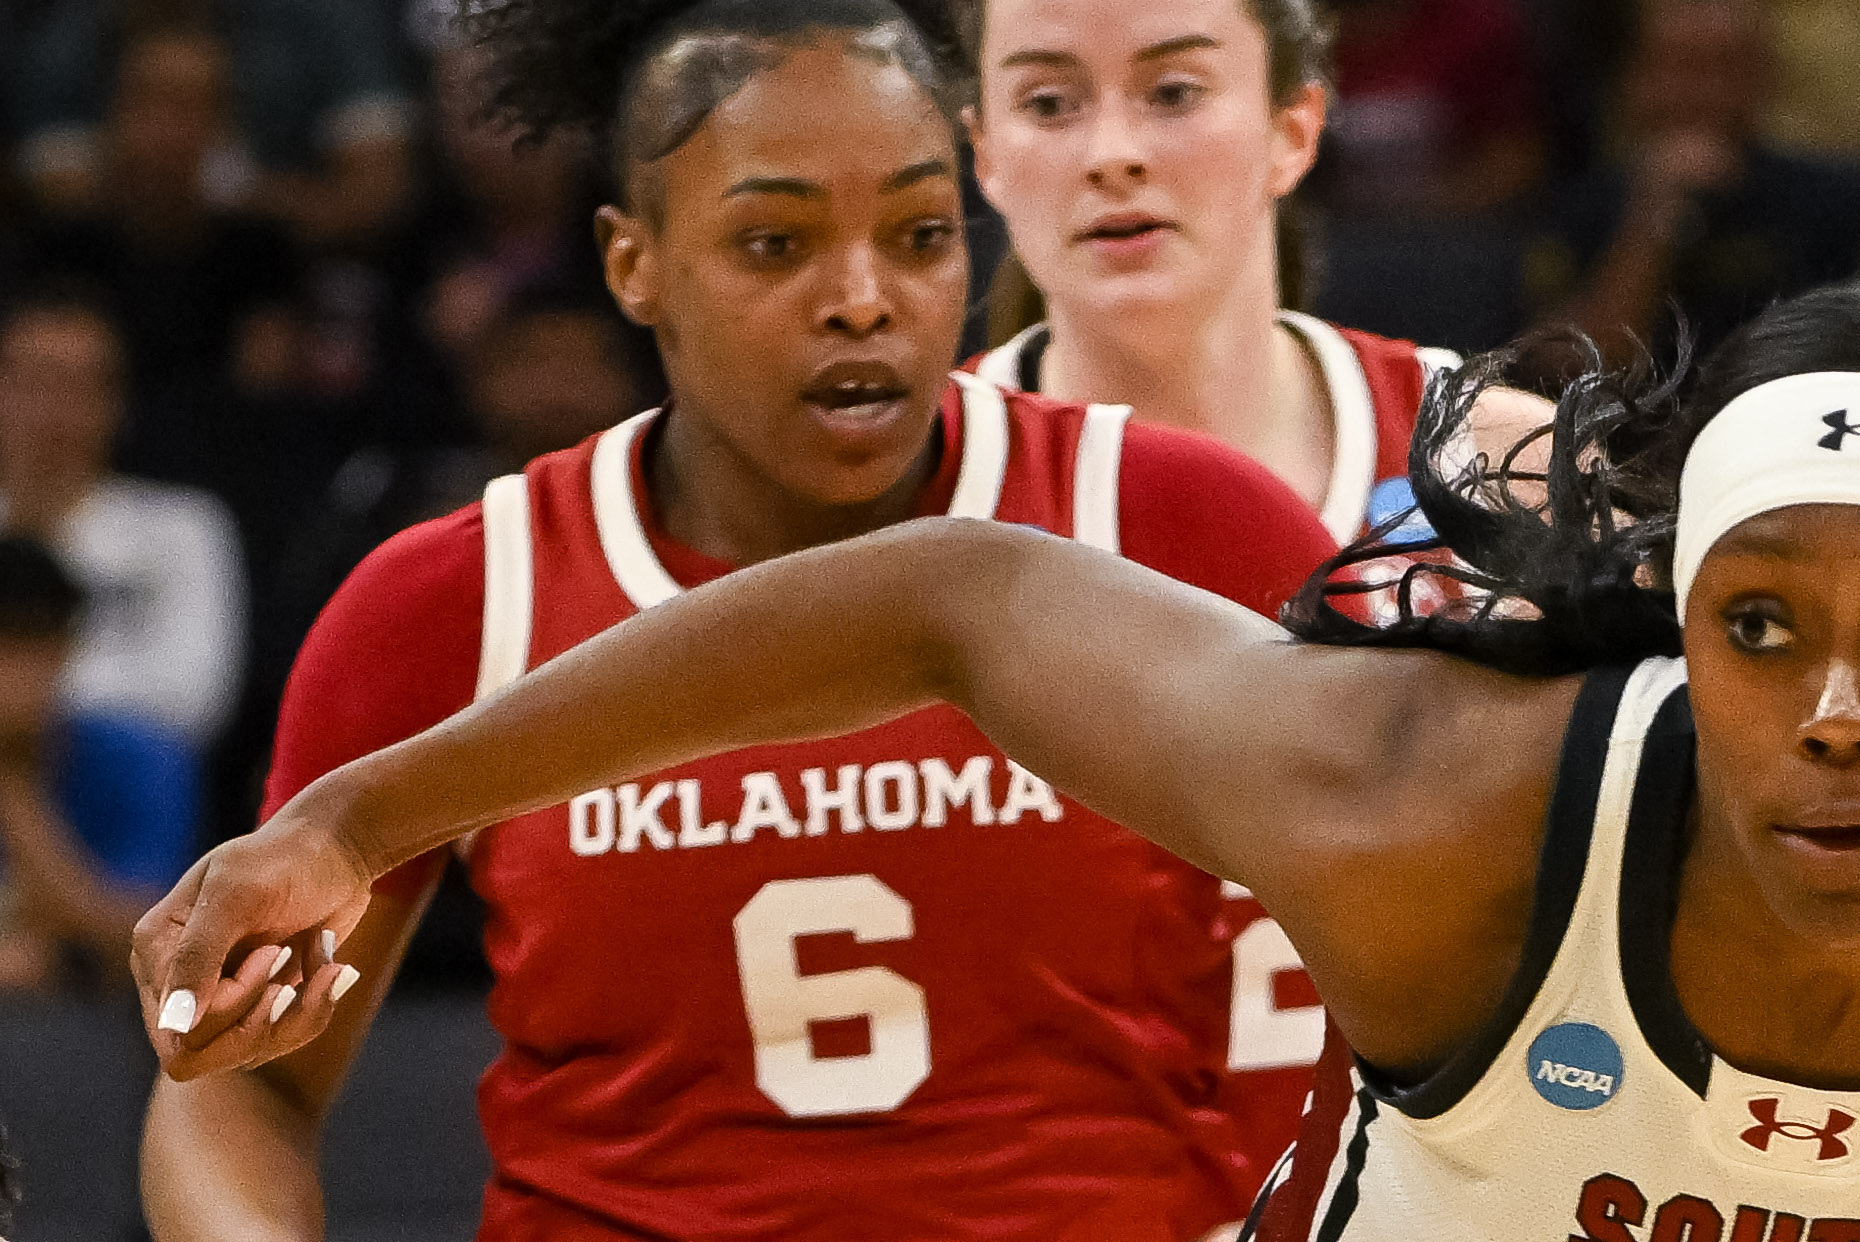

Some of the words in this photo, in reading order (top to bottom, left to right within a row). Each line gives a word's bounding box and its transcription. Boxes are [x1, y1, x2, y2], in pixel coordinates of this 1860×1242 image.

[568, 755, 1065, 857] OKLAHOMA
[732, 872, 933, 1119] 6
[1535, 1059, 1615, 1096] NCAA
